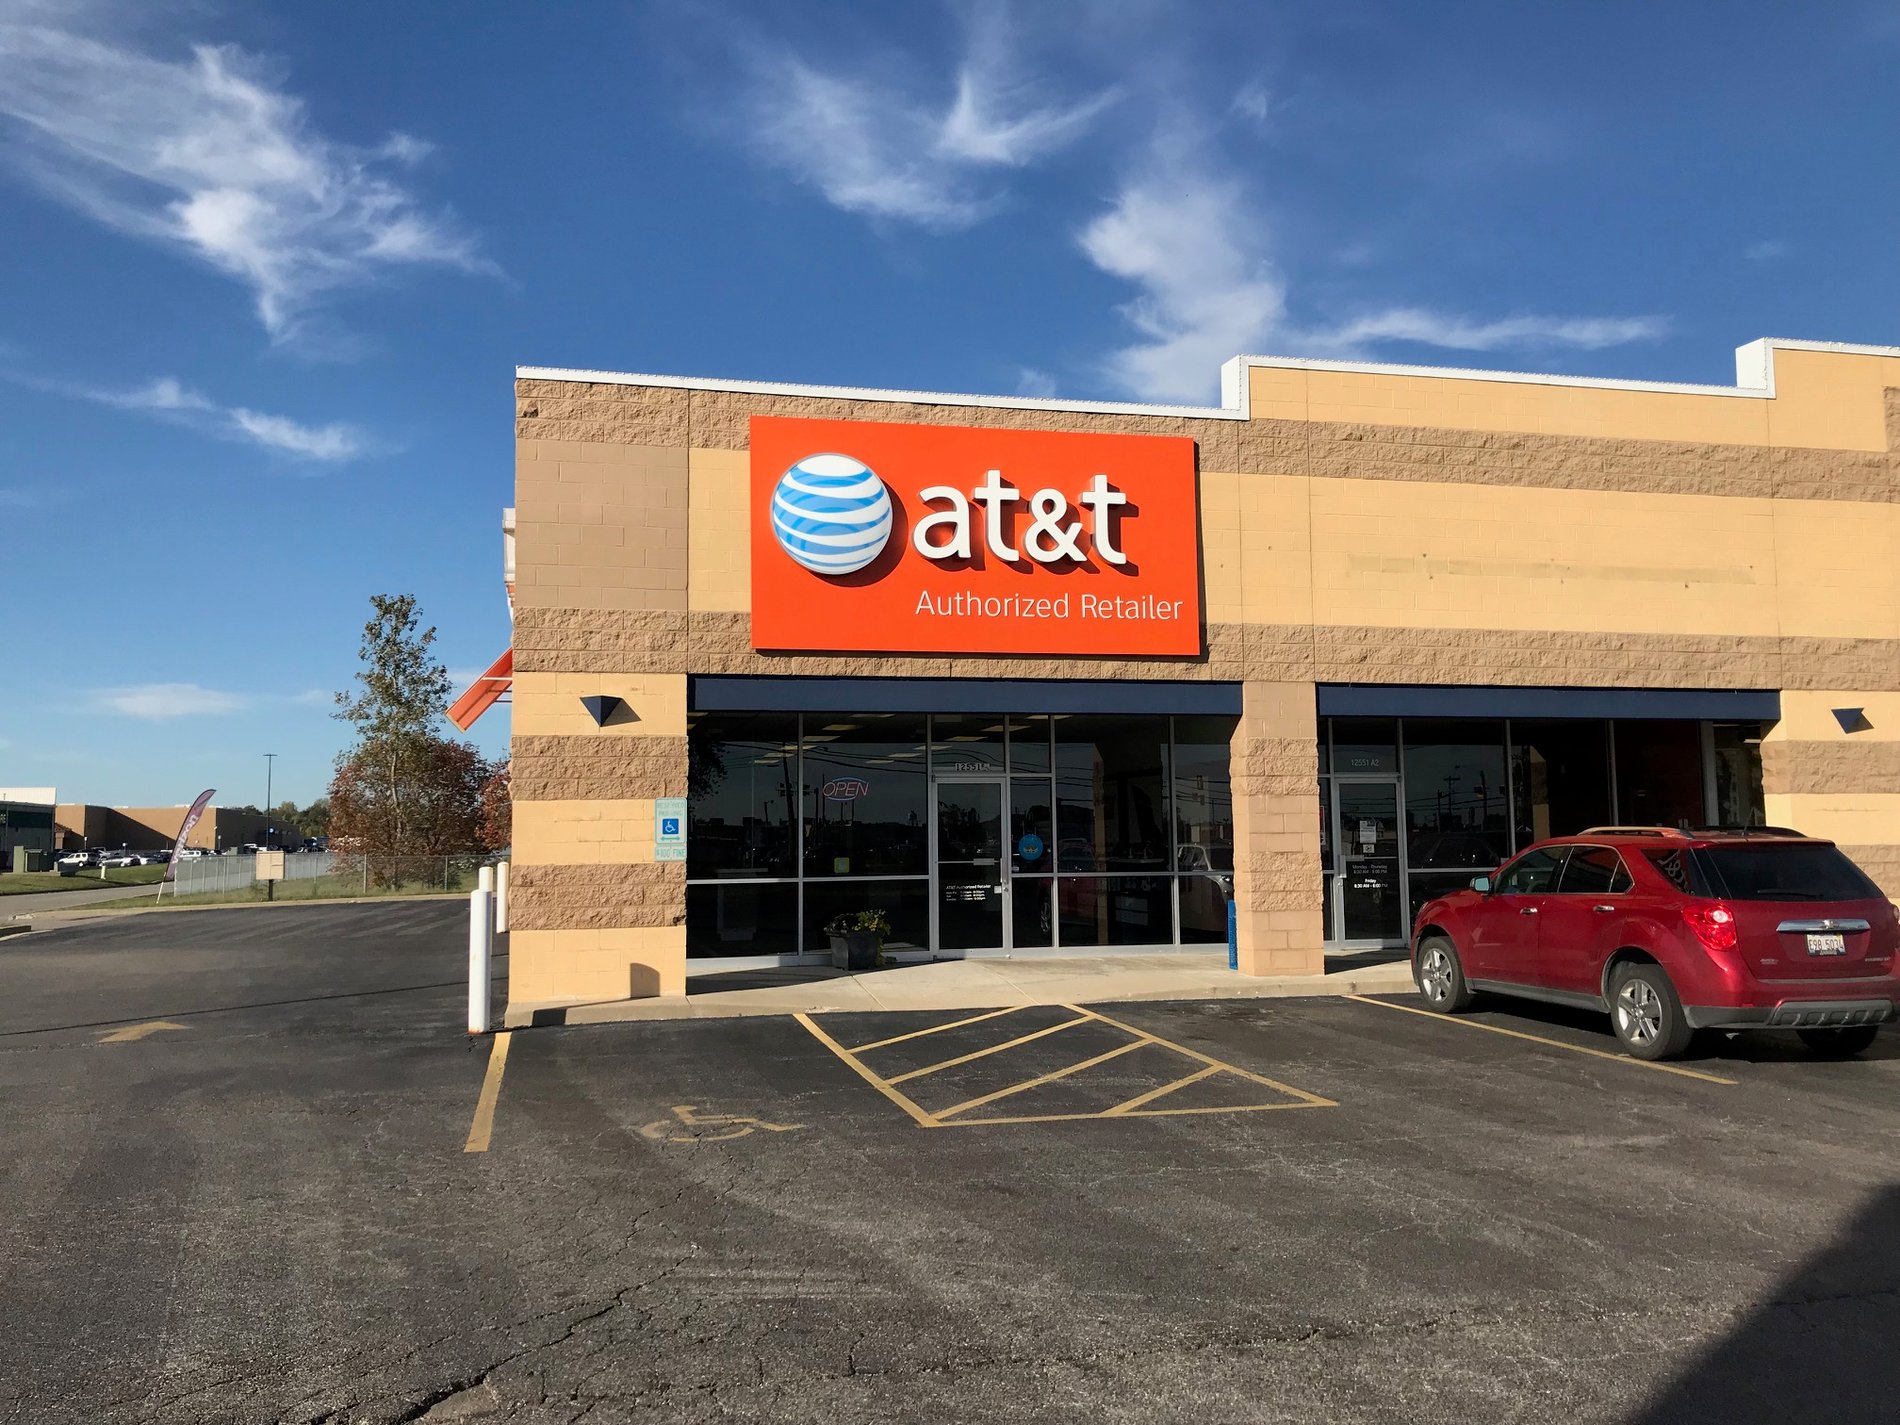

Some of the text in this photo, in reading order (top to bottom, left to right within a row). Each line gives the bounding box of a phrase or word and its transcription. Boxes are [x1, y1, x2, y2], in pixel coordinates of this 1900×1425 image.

[912, 469, 1127, 565] at&t
[915, 590, 1184, 620] Authorized Retailer
[954, 763, 981, 771] 12551
[1351, 758, 1369, 767] 12551
[823, 781, 869, 796] OPEN
